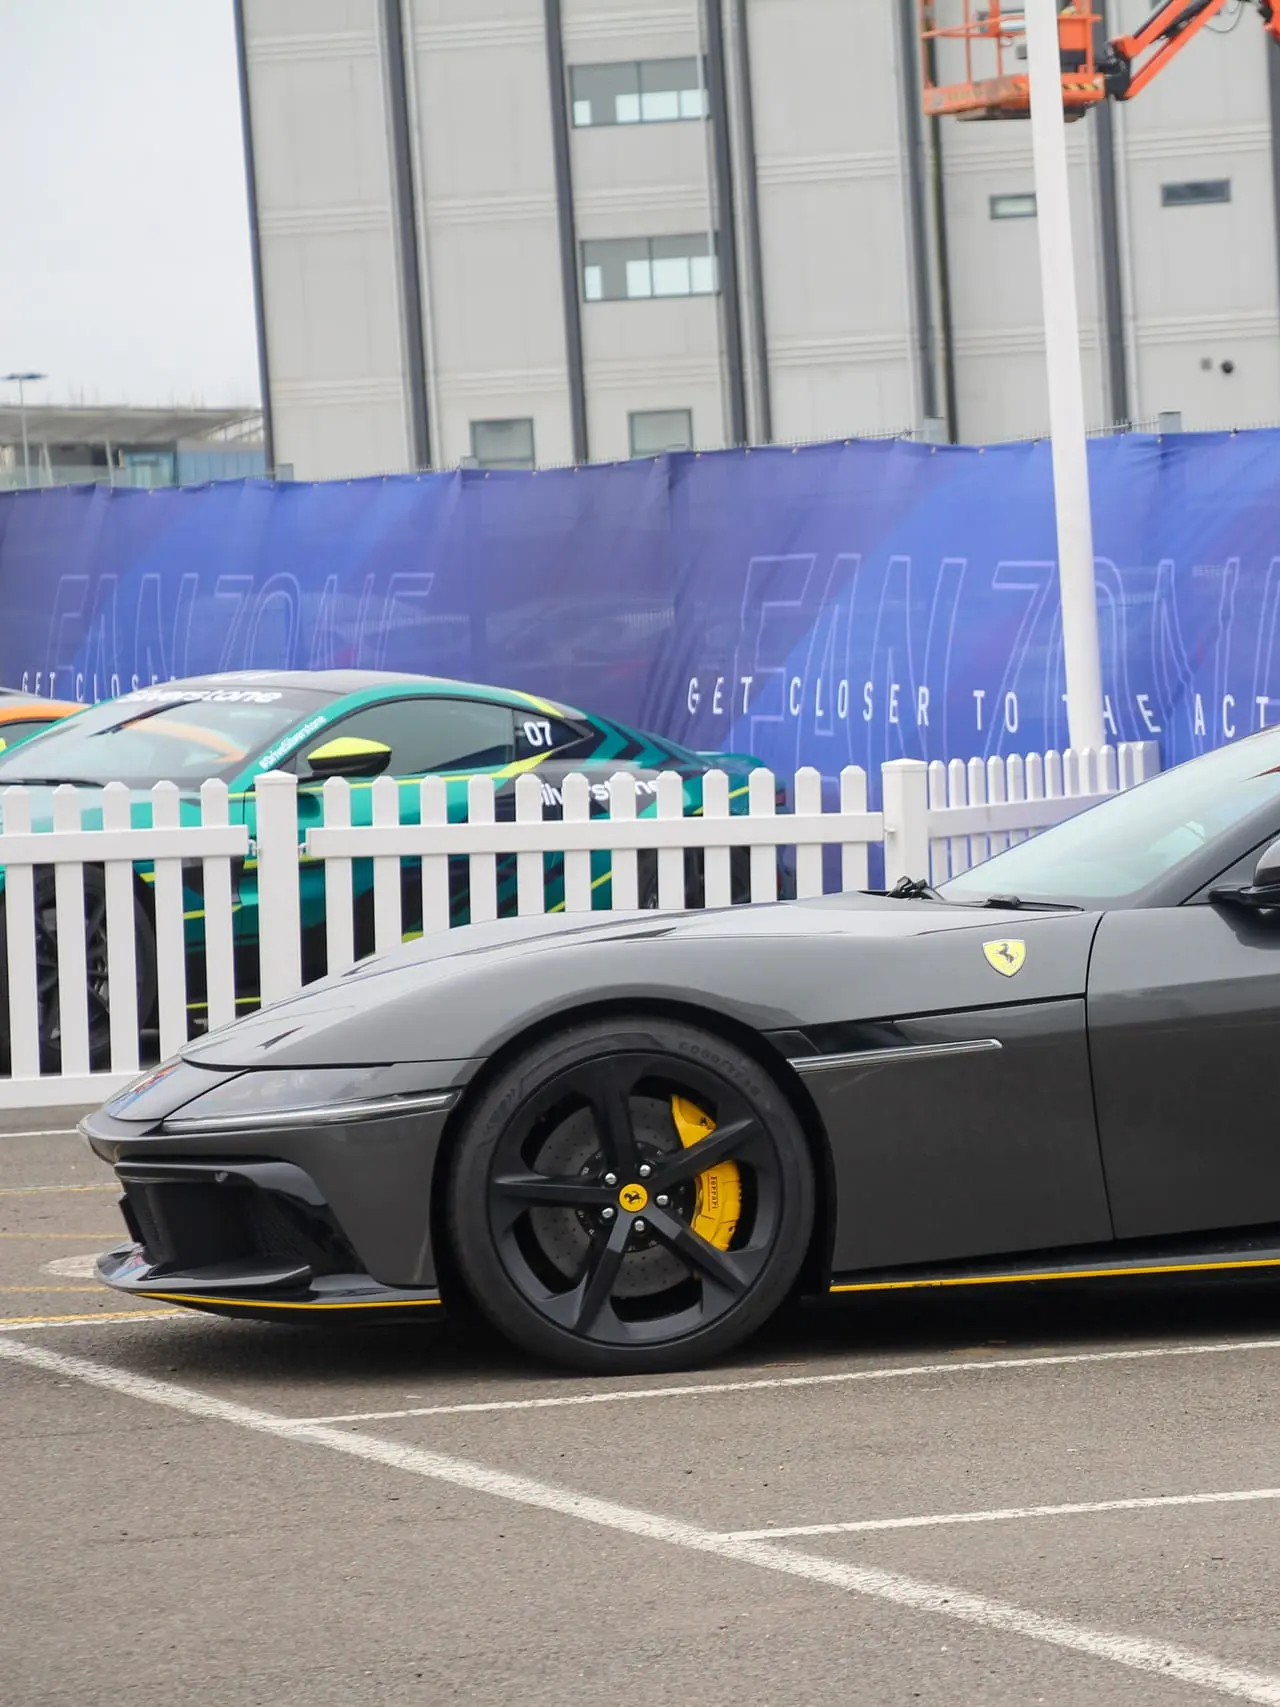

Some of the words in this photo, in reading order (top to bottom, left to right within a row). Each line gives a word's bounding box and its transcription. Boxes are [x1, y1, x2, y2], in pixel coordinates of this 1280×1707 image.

[76, 672, 177, 704] CLOS
[687, 676, 752, 714] GET
[789, 676, 930, 727] CLOSER
[973, 690, 1019, 734] TO
[1061, 693, 1162, 736] HE
[523, 721, 553, 747] 07
